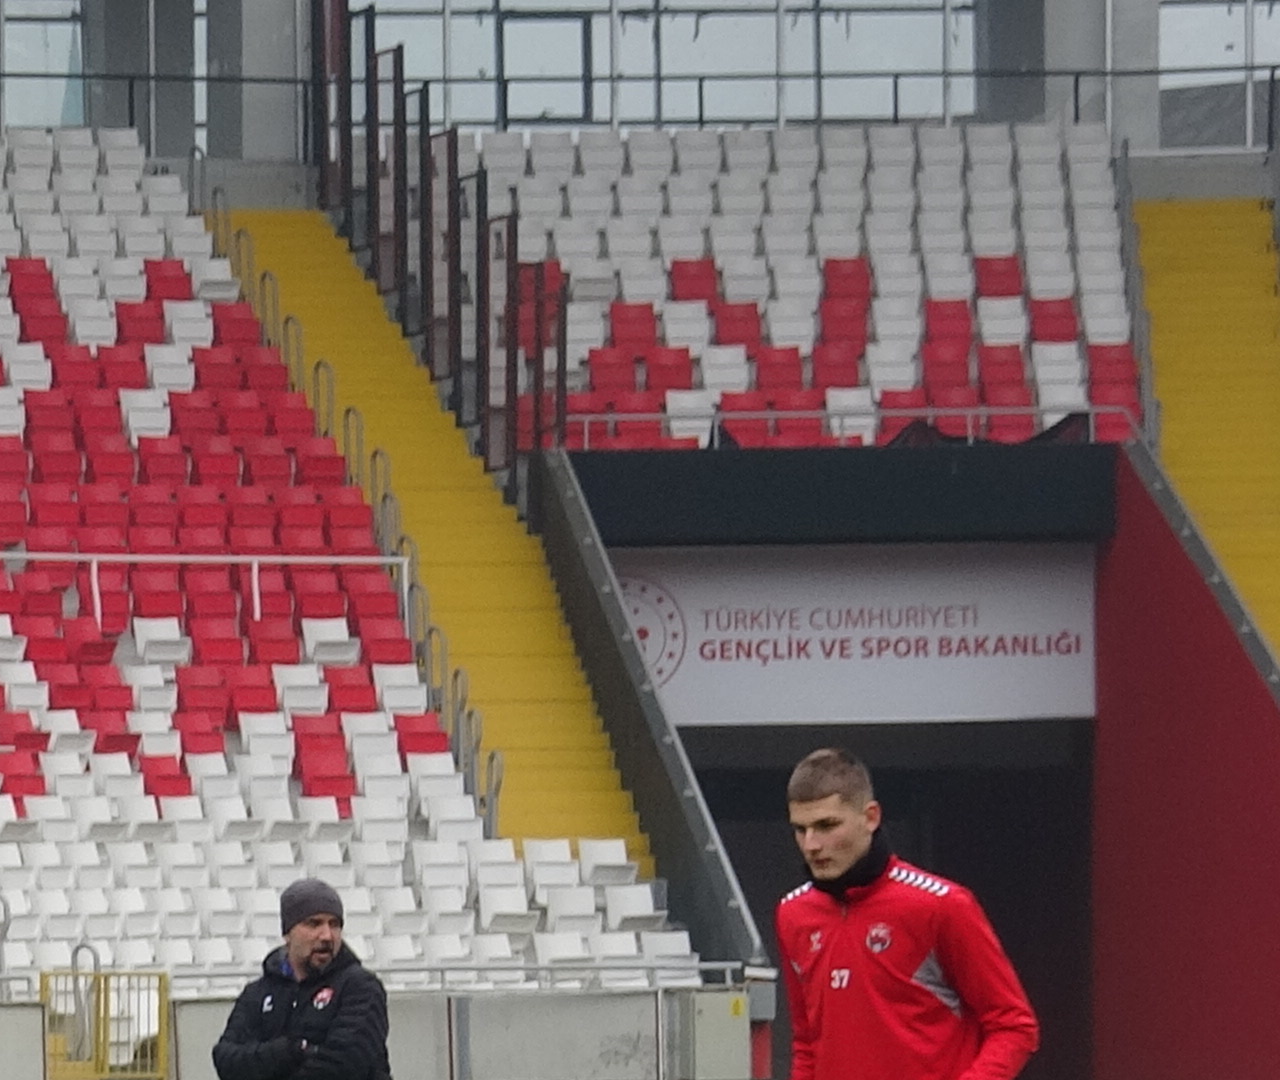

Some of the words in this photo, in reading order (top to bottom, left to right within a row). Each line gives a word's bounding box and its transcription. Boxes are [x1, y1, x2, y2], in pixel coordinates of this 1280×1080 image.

[702, 605, 801, 631] TÜRKİYE
[699, 635, 811, 666] GENÇLİK
[819, 638, 853, 660] VE
[860, 636, 930, 659] SPOR
[938, 628, 1081, 657] BAKANLIĞI
[830, 968, 851, 989] 37
